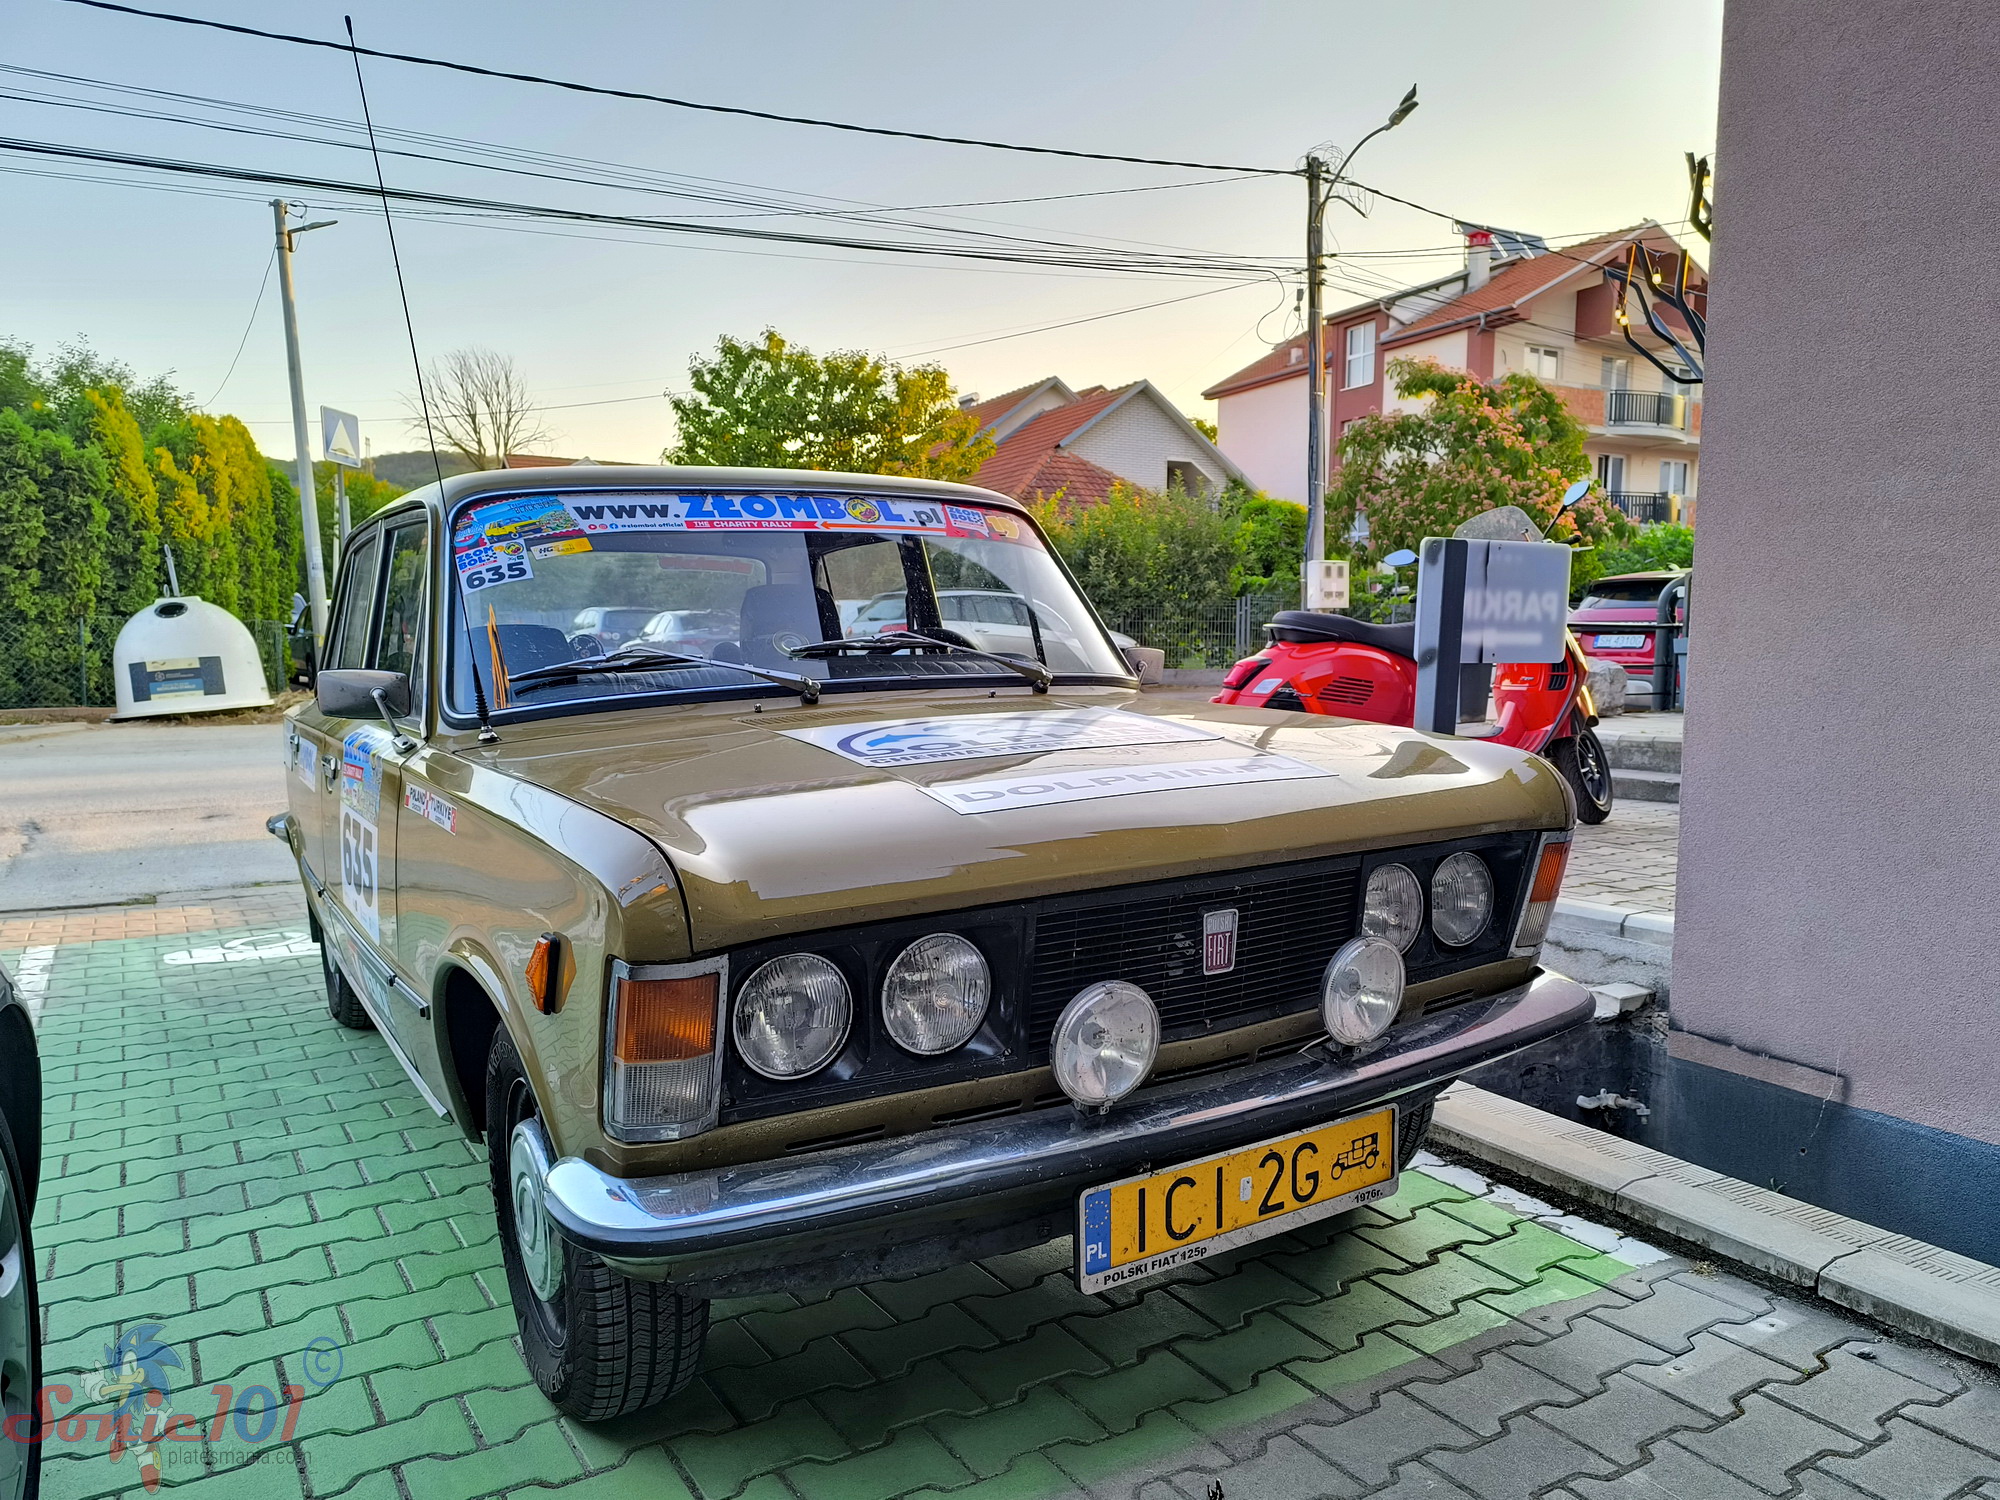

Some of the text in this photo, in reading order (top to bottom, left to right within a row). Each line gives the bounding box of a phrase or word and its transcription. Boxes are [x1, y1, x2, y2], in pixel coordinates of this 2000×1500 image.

[985, 515, 1020, 539] 19
[456, 545, 494, 564] ZŁOM
[458, 556, 486, 571] BOL
[466, 561, 527, 590] 635
[870, 750, 983, 764] CHEMIA
[953, 762, 1301, 803] DOLPHIN.PL
[342, 811, 373, 907] 635
[1207, 914, 1232, 932] POLSKI
[1208, 932, 1231, 966] FIAT
[1258, 1141, 1319, 1216] 2G
[1354, 1188, 1383, 1203] 1976r.
[1086, 1242, 1107, 1262] PL
[1103, 1246, 1207, 1285] POLSKI FIAT 125p
